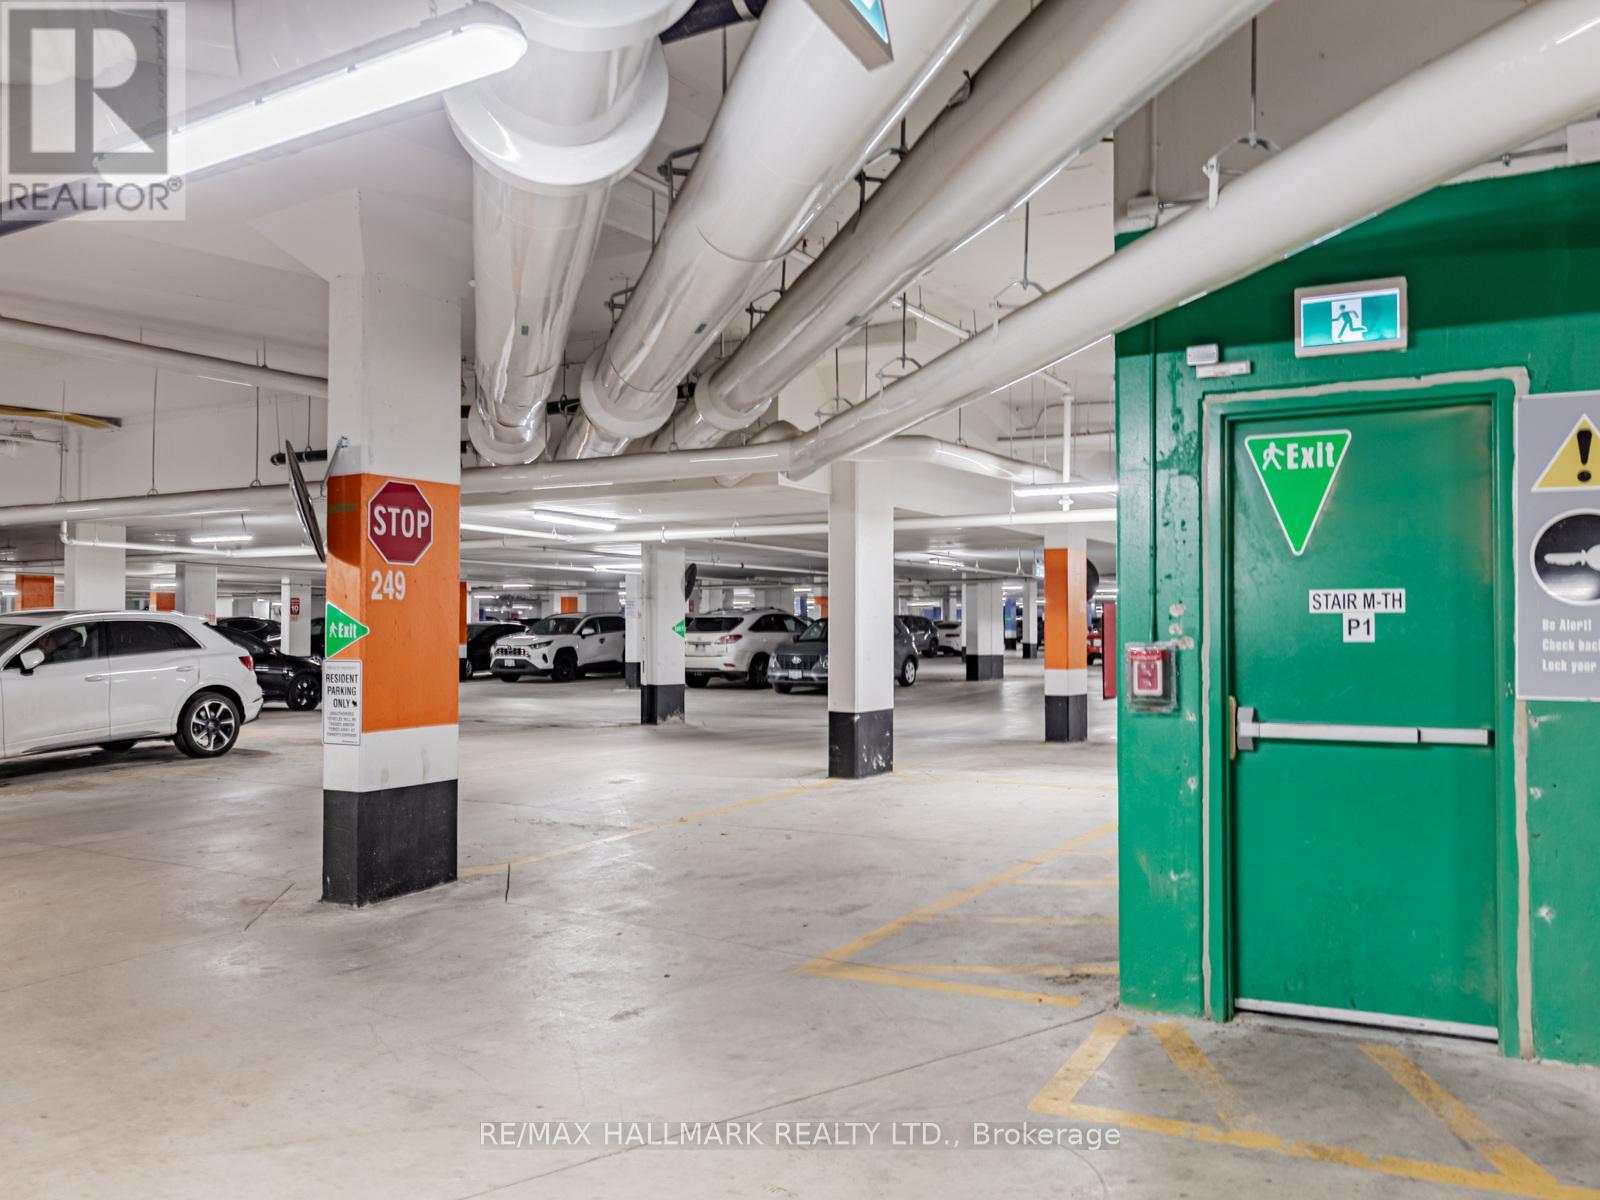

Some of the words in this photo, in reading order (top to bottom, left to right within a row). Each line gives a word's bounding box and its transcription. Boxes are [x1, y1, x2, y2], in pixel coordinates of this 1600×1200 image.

[1286, 441, 1335, 470] Exit
[373, 505, 430, 539] STOP
[371, 570, 406, 601] 249
[1312, 592, 1358, 610] STAIR
[1363, 592, 1402, 609] M-TH
[338, 622, 357, 639] Exit
[1348, 618, 1370, 636] P1
[1542, 639, 1575, 652] Check
[1542, 659, 1567, 673] Lock
[1571, 661, 1597, 675] your
[325, 673, 358, 684] RESIDENT
[327, 686, 357, 696] PARKING
[333, 698, 350, 708] ONLY
